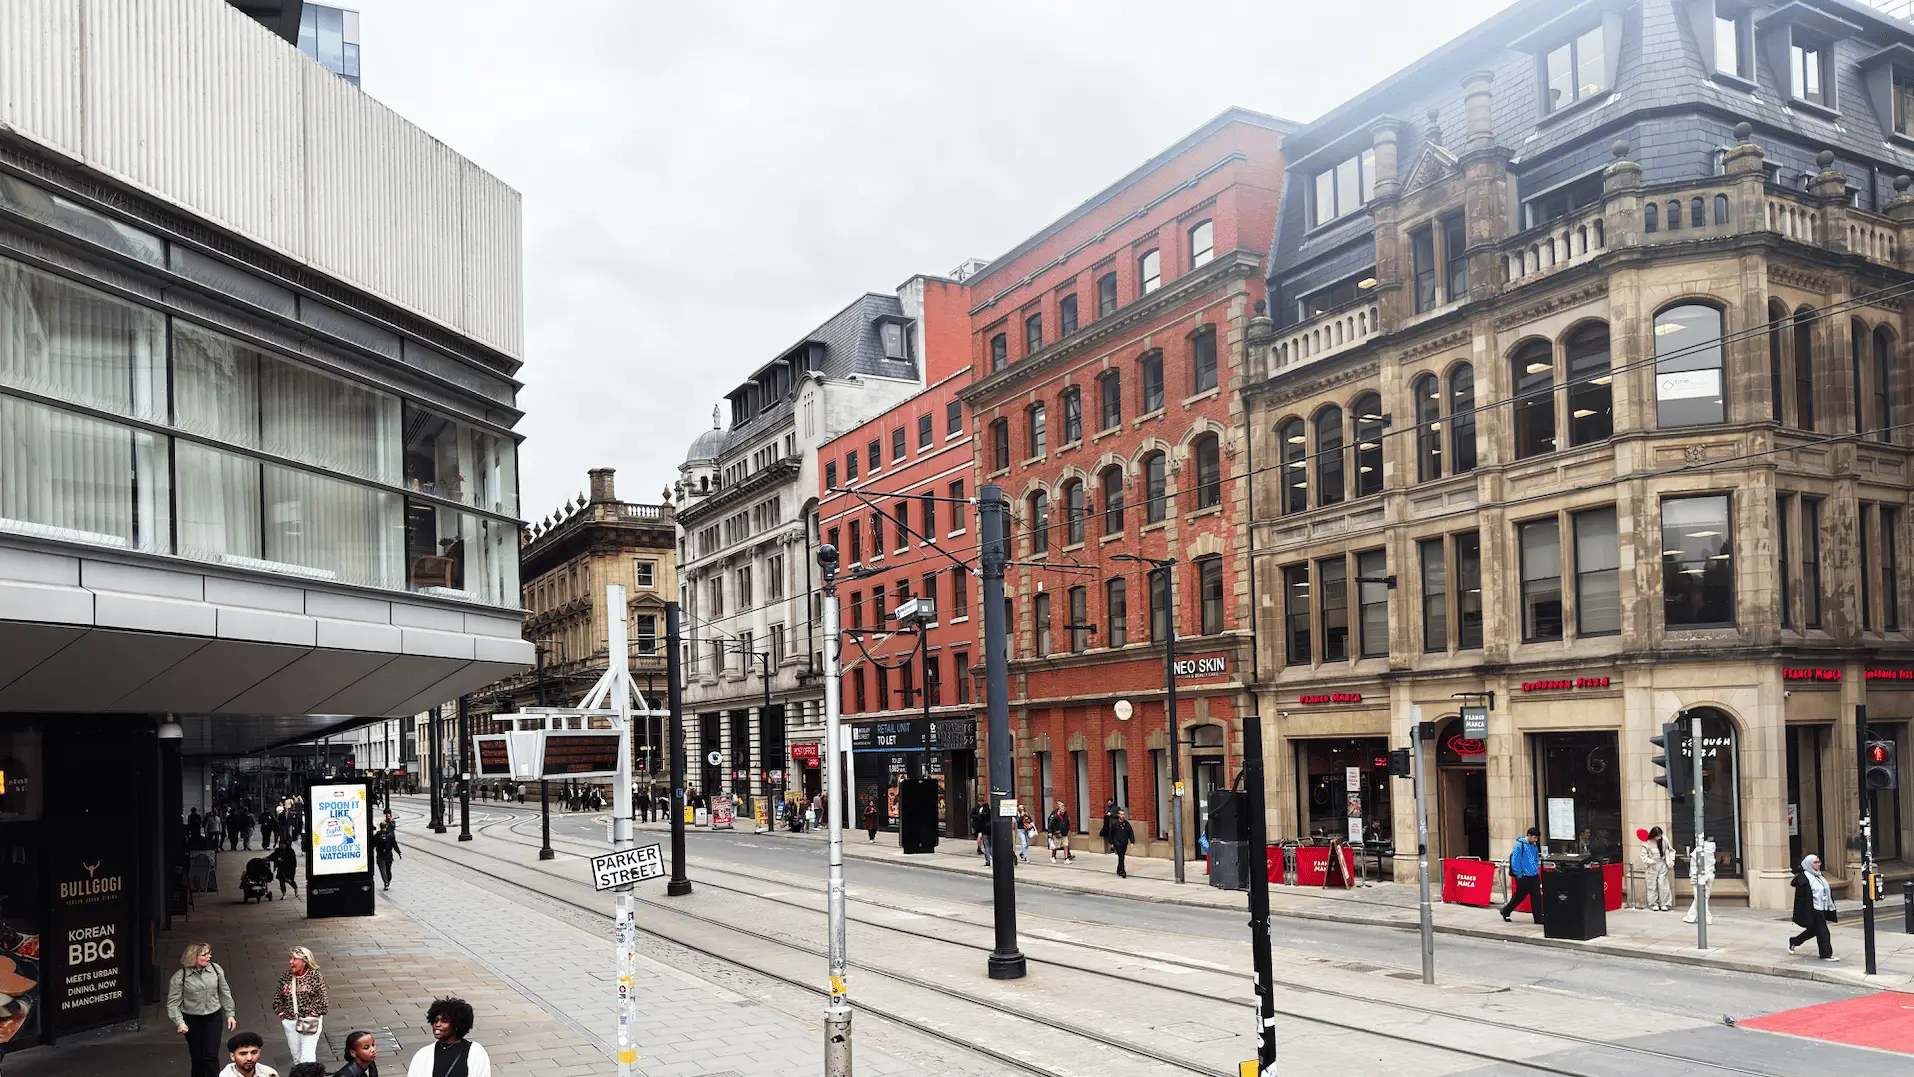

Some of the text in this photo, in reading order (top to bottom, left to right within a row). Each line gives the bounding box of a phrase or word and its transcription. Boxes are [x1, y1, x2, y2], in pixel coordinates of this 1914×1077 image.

[1174, 657, 1224, 675] NEO SKIN
[1782, 668, 1842, 680] FRANCO MANCA
[1864, 669, 1914, 680] SOURDOUGH PIZZ
[1521, 676, 1610, 692] SOURDOUGH PIZZA
[1299, 693, 1361, 704] FRANCO MANCA
[877, 722, 910, 734] RETAIL UNIT
[877, 736, 885, 745] TO
[886, 735, 896, 745] LET
[794, 746, 816, 756] POST OFFICE
[1682, 748, 1716, 757] PIZA
[319, 800, 360, 810] SPOON IT
[330, 810, 349, 818] LIKE
[320, 844, 361, 853] NOBODY'S
[320, 852, 361, 860] WATCHING
[596, 848, 657, 872] PARKER
[600, 862, 657, 886] STREET
[60, 876, 122, 898] BULLGOGI
[1457, 880, 1475, 888] MANCA
[68, 924, 115, 942] KOREAN
[69, 938, 115, 966] BBQ
[66, 967, 118, 985] MEETS URBAN
[98, 980, 117, 991] NOW
[62, 990, 122, 1010] IN MANCHESTER
